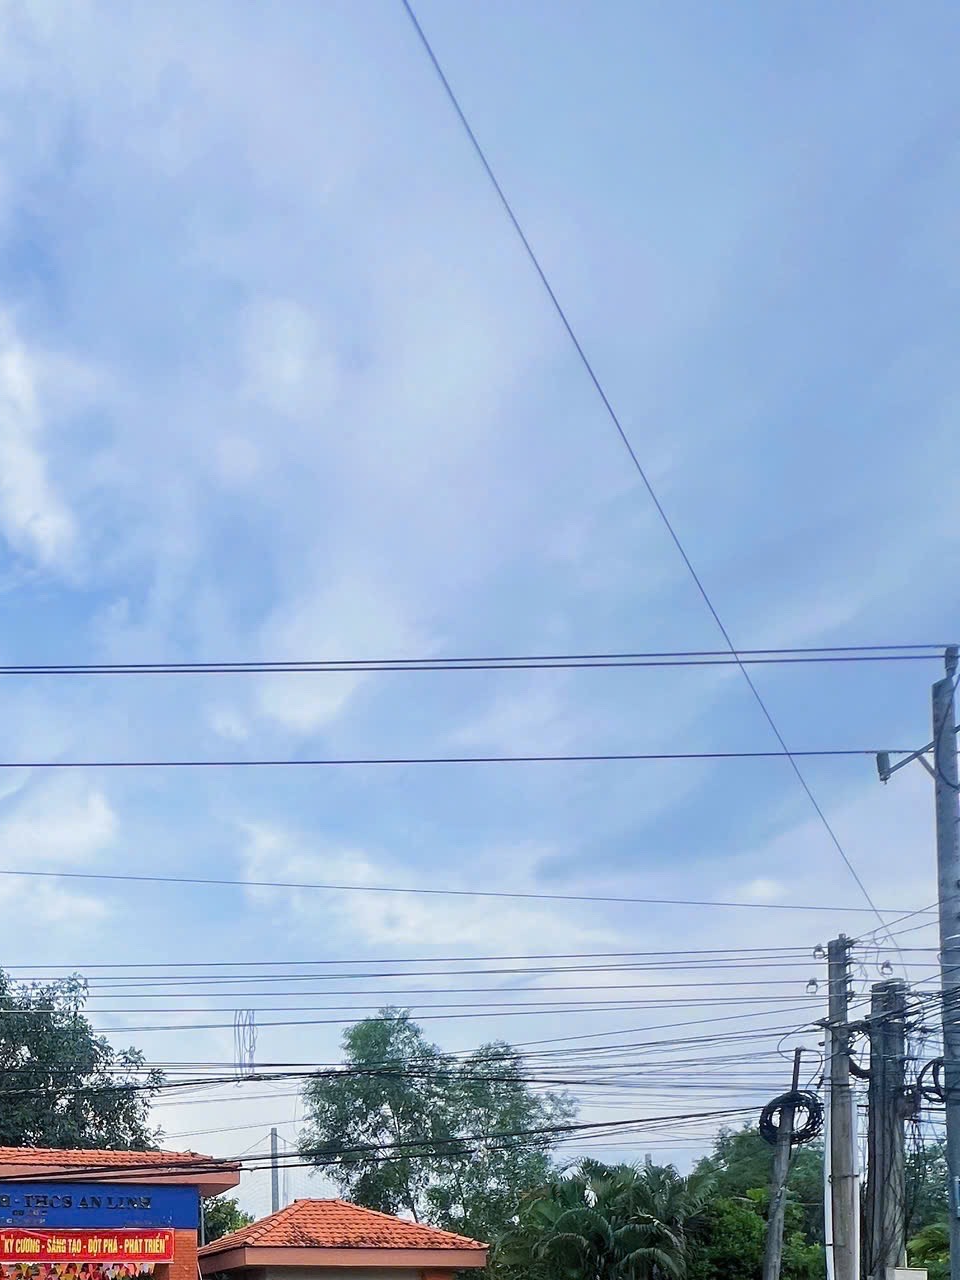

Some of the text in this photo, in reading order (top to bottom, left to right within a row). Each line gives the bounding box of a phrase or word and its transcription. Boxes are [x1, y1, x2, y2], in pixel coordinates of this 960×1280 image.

[24, 1194, 73, 1208] THCS
[78, 1196, 102, 1209] AN
[46, 1235, 67, 1254] SÁNG
[68, 1238, 82, 1257] TẠO
[87, 1235, 102, 1257] ĐỘT
[103, 1235, 118, 1254] PHÁ
[124, 1235, 143, 1254] PHÁT
